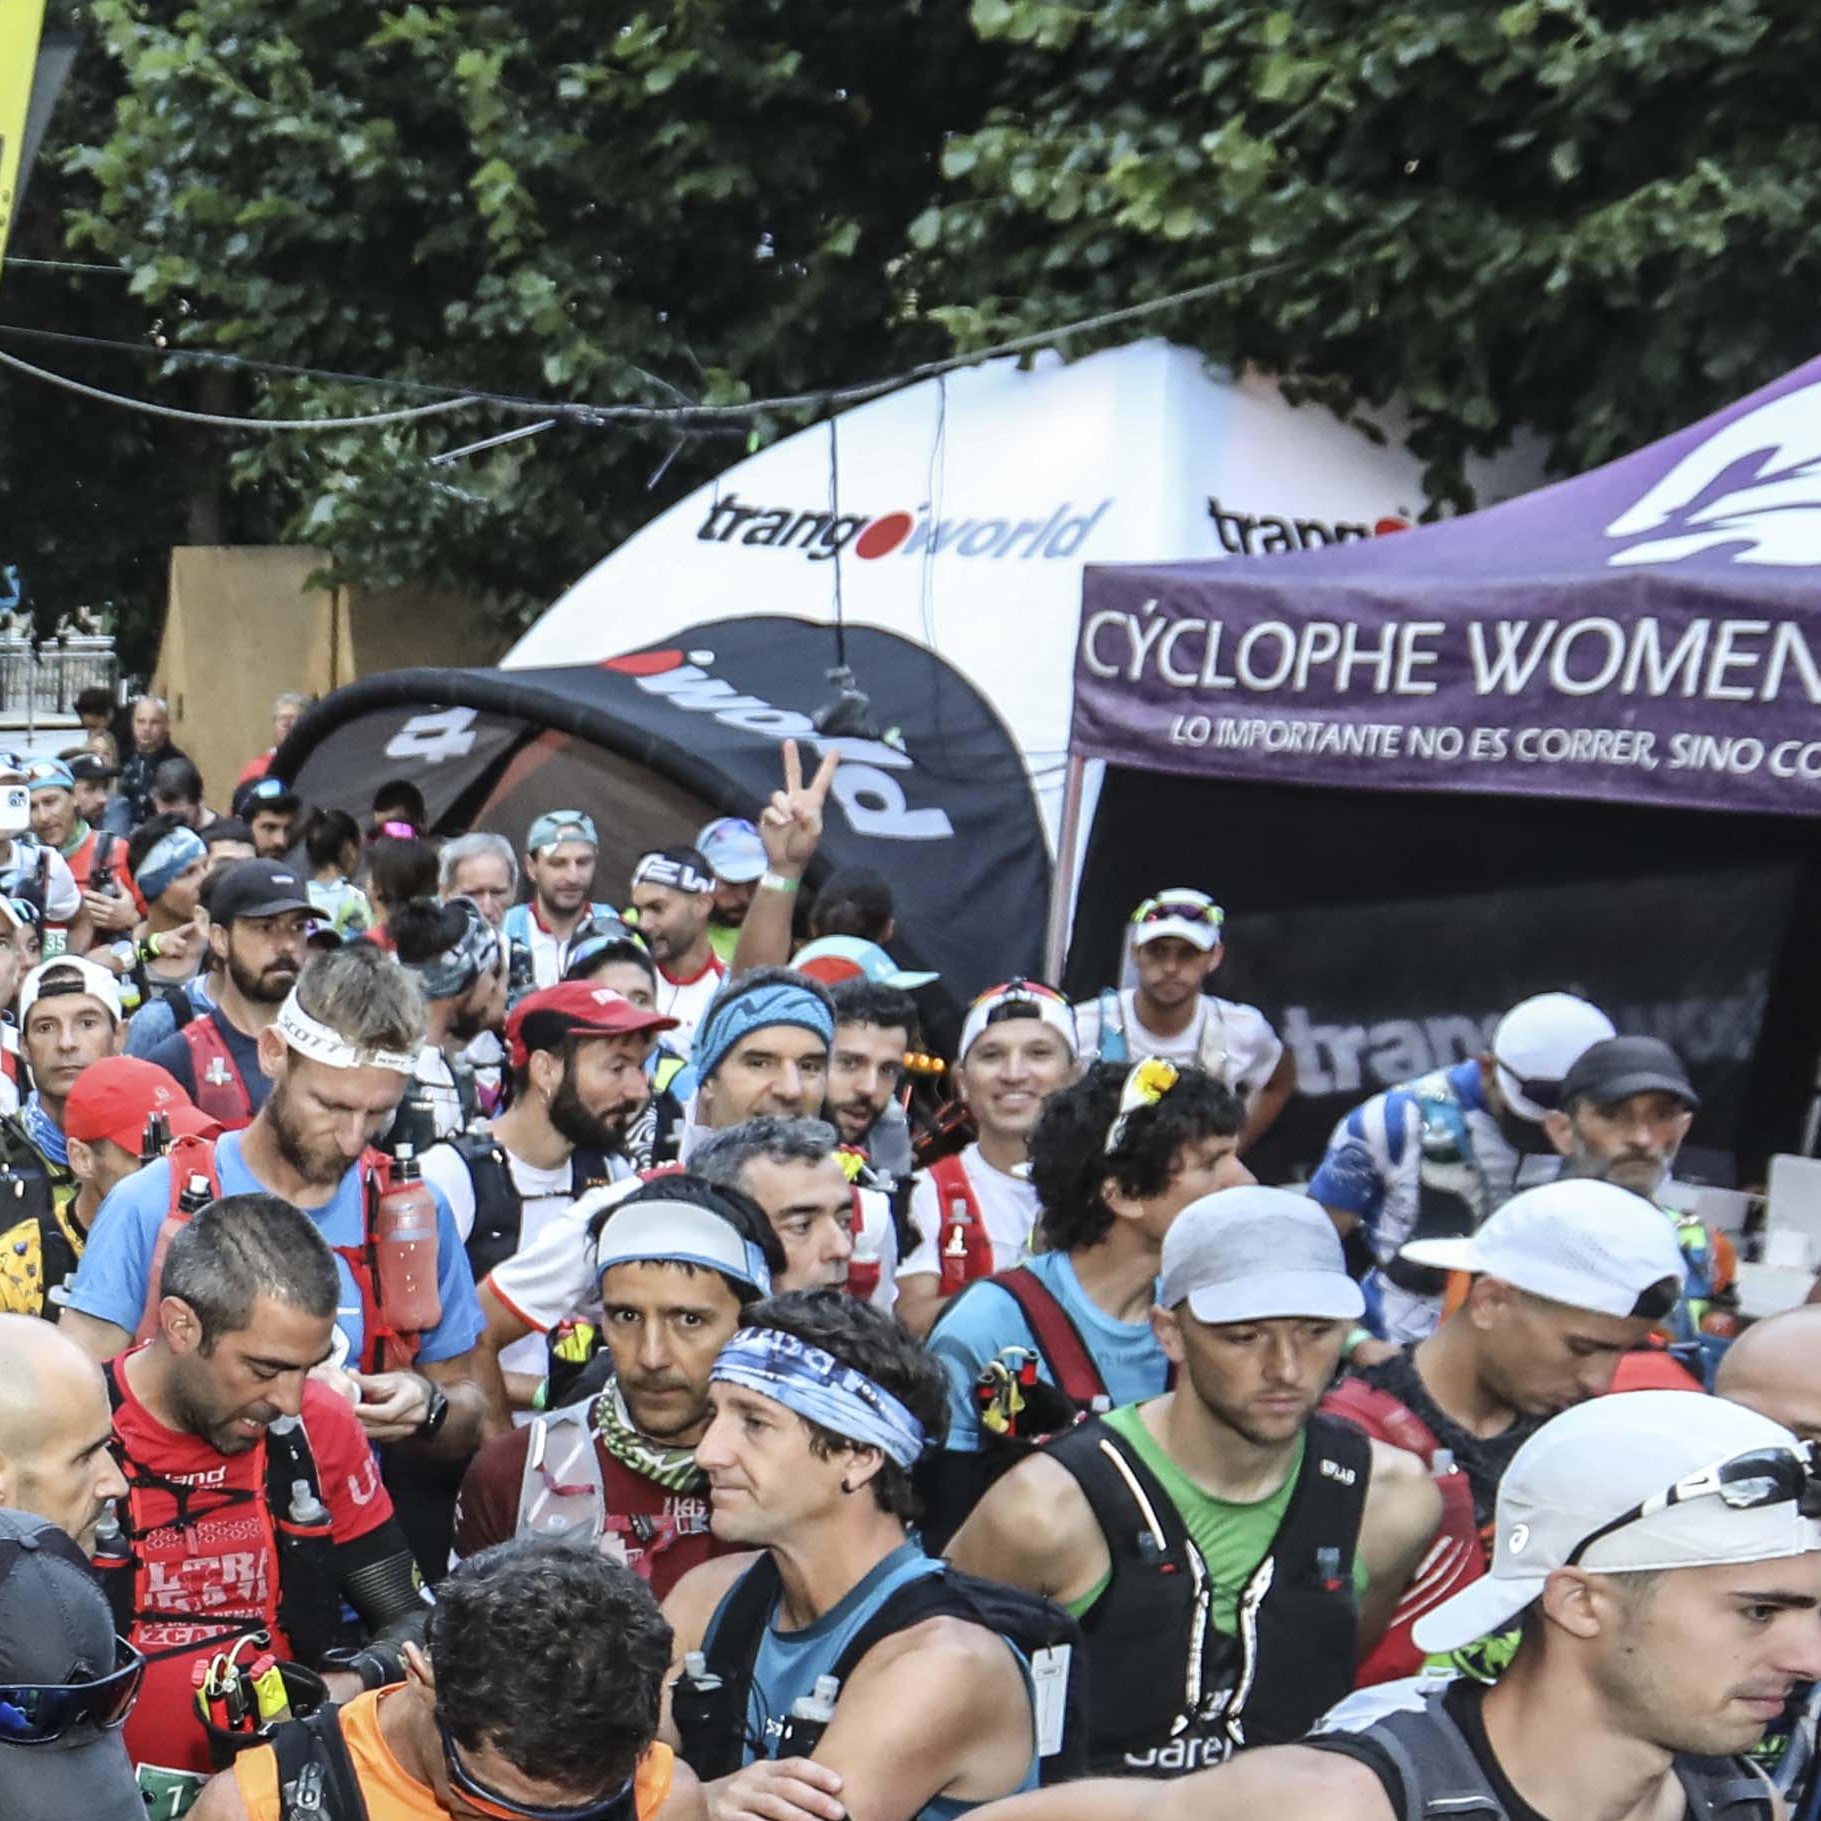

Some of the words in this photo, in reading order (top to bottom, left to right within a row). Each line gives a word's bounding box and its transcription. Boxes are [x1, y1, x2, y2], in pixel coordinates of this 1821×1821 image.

[1170, 715, 1211, 747] LO
[1217, 719, 1404, 759] IMPORTANTE
[1409, 725, 1464, 760] NO
[1469, 727, 1510, 761] ES
[1668, 732, 1765, 774] SINO
